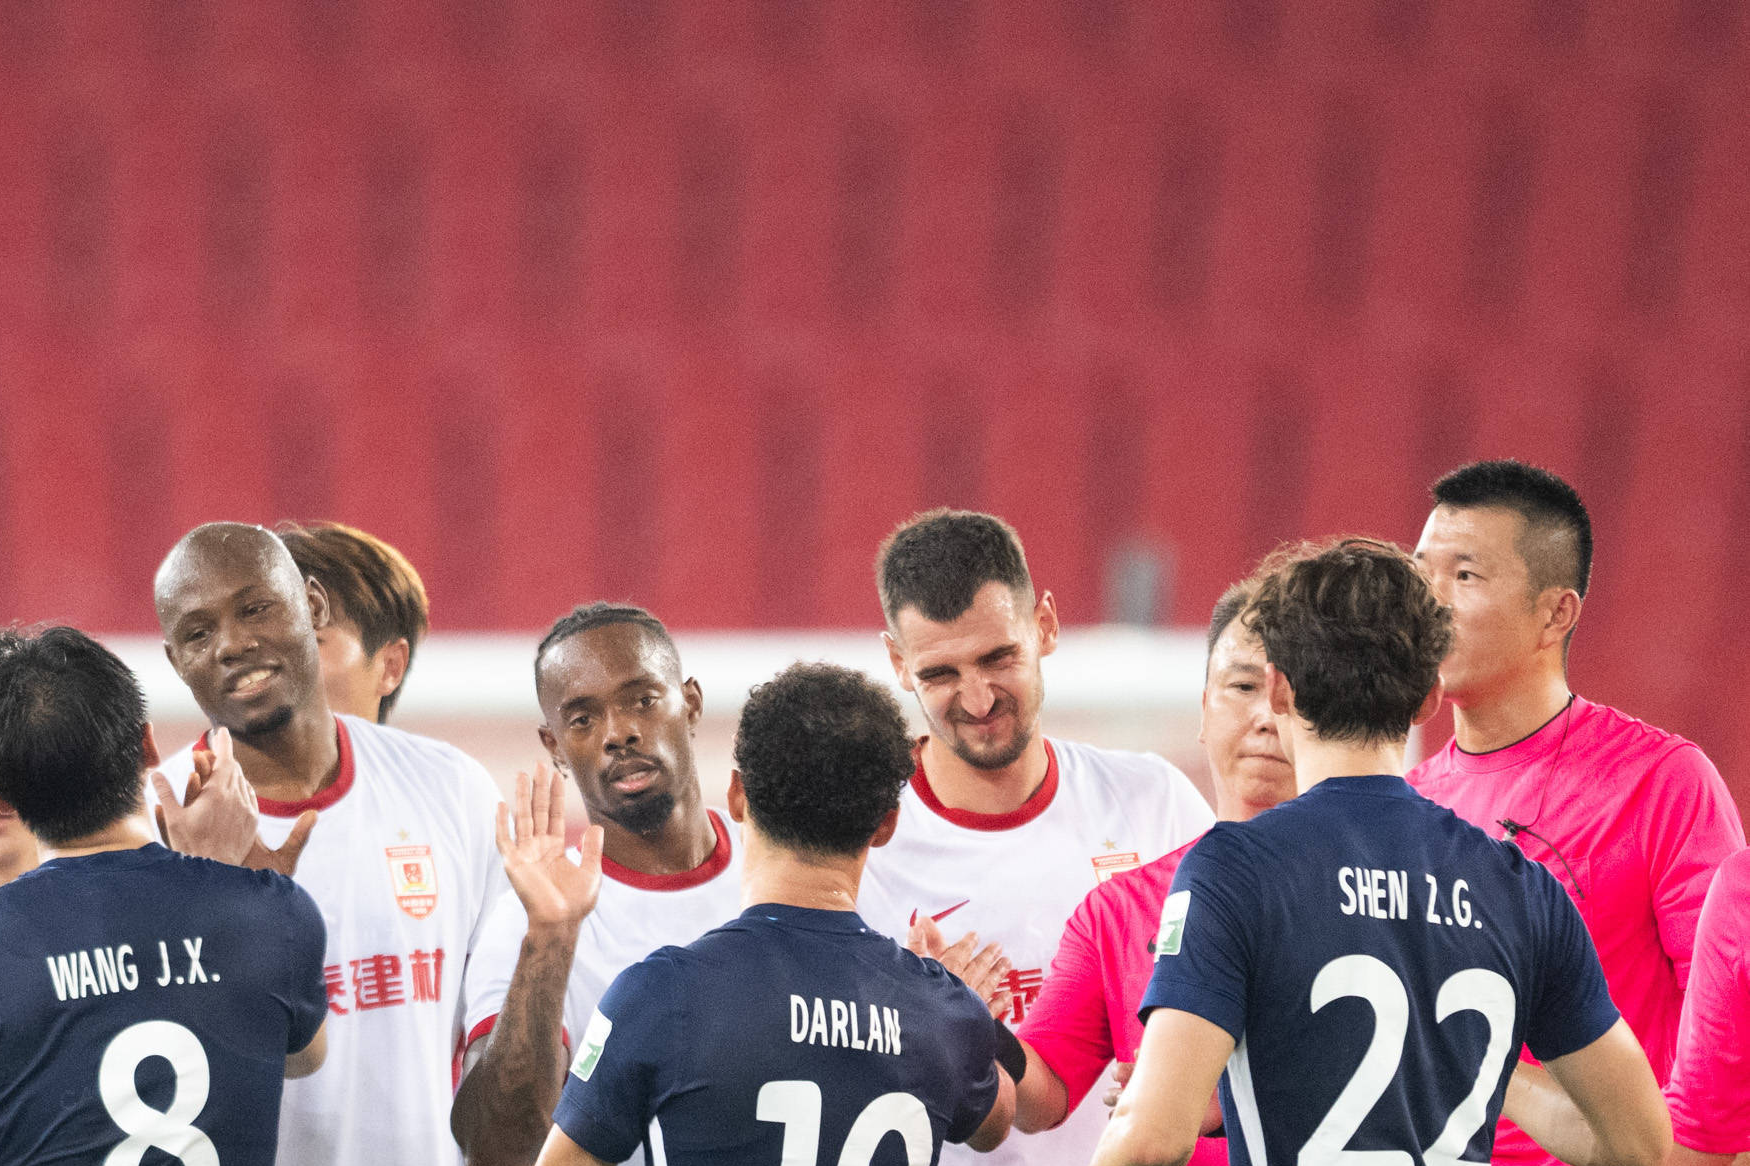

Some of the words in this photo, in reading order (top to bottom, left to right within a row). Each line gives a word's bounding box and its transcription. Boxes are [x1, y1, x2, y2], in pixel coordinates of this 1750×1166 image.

[1337, 866, 1408, 920] SHEN
[1425, 872, 1483, 930] Z.G.
[46, 944, 139, 1002] WANG
[156, 936, 221, 988] J.X.
[789, 994, 902, 1056] DARLAN
